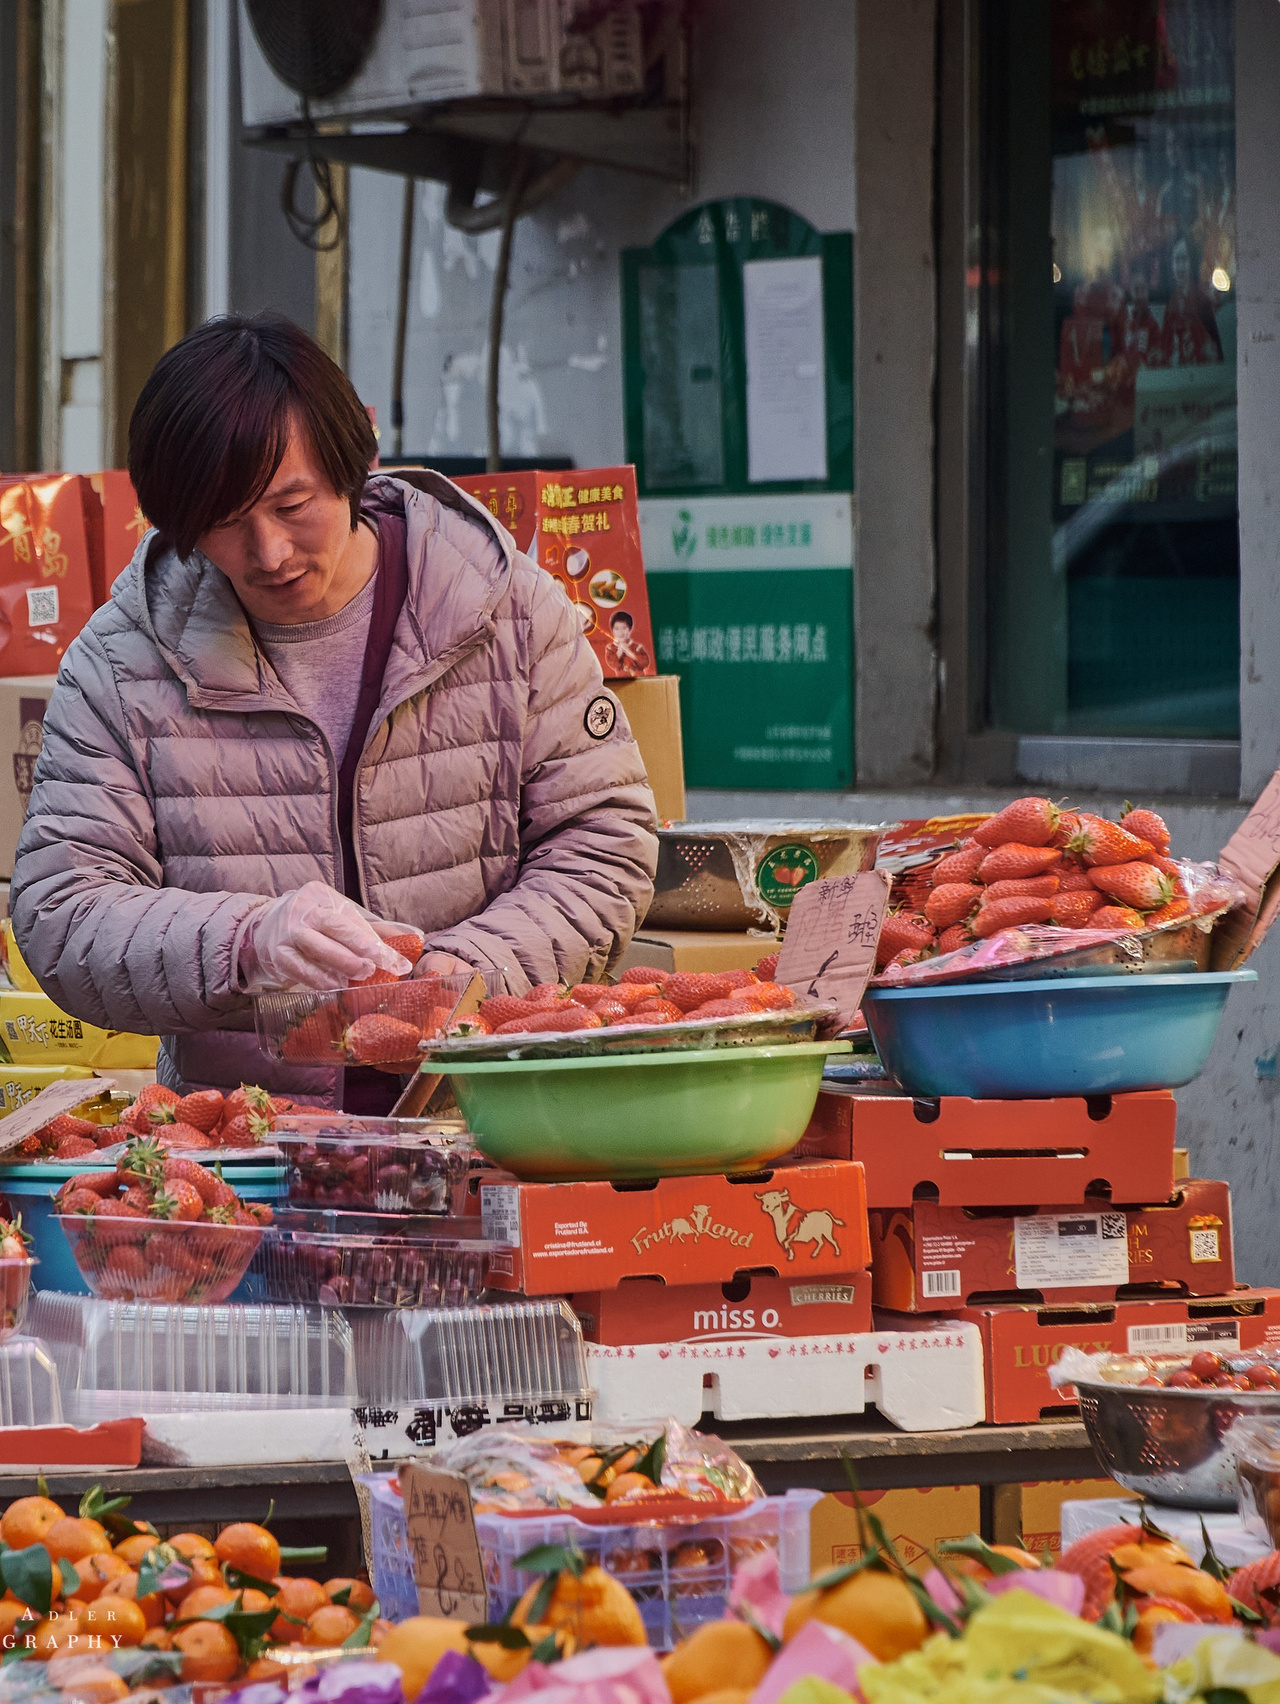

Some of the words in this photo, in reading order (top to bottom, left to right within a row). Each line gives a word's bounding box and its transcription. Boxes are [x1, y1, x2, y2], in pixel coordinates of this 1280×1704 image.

[49, 1019, 84, 1040] 花生汤圆
[554, 1221, 577, 1229] Exported
[555, 1228, 578, 1236] Frutland
[693, 1304, 755, 1330] miss
